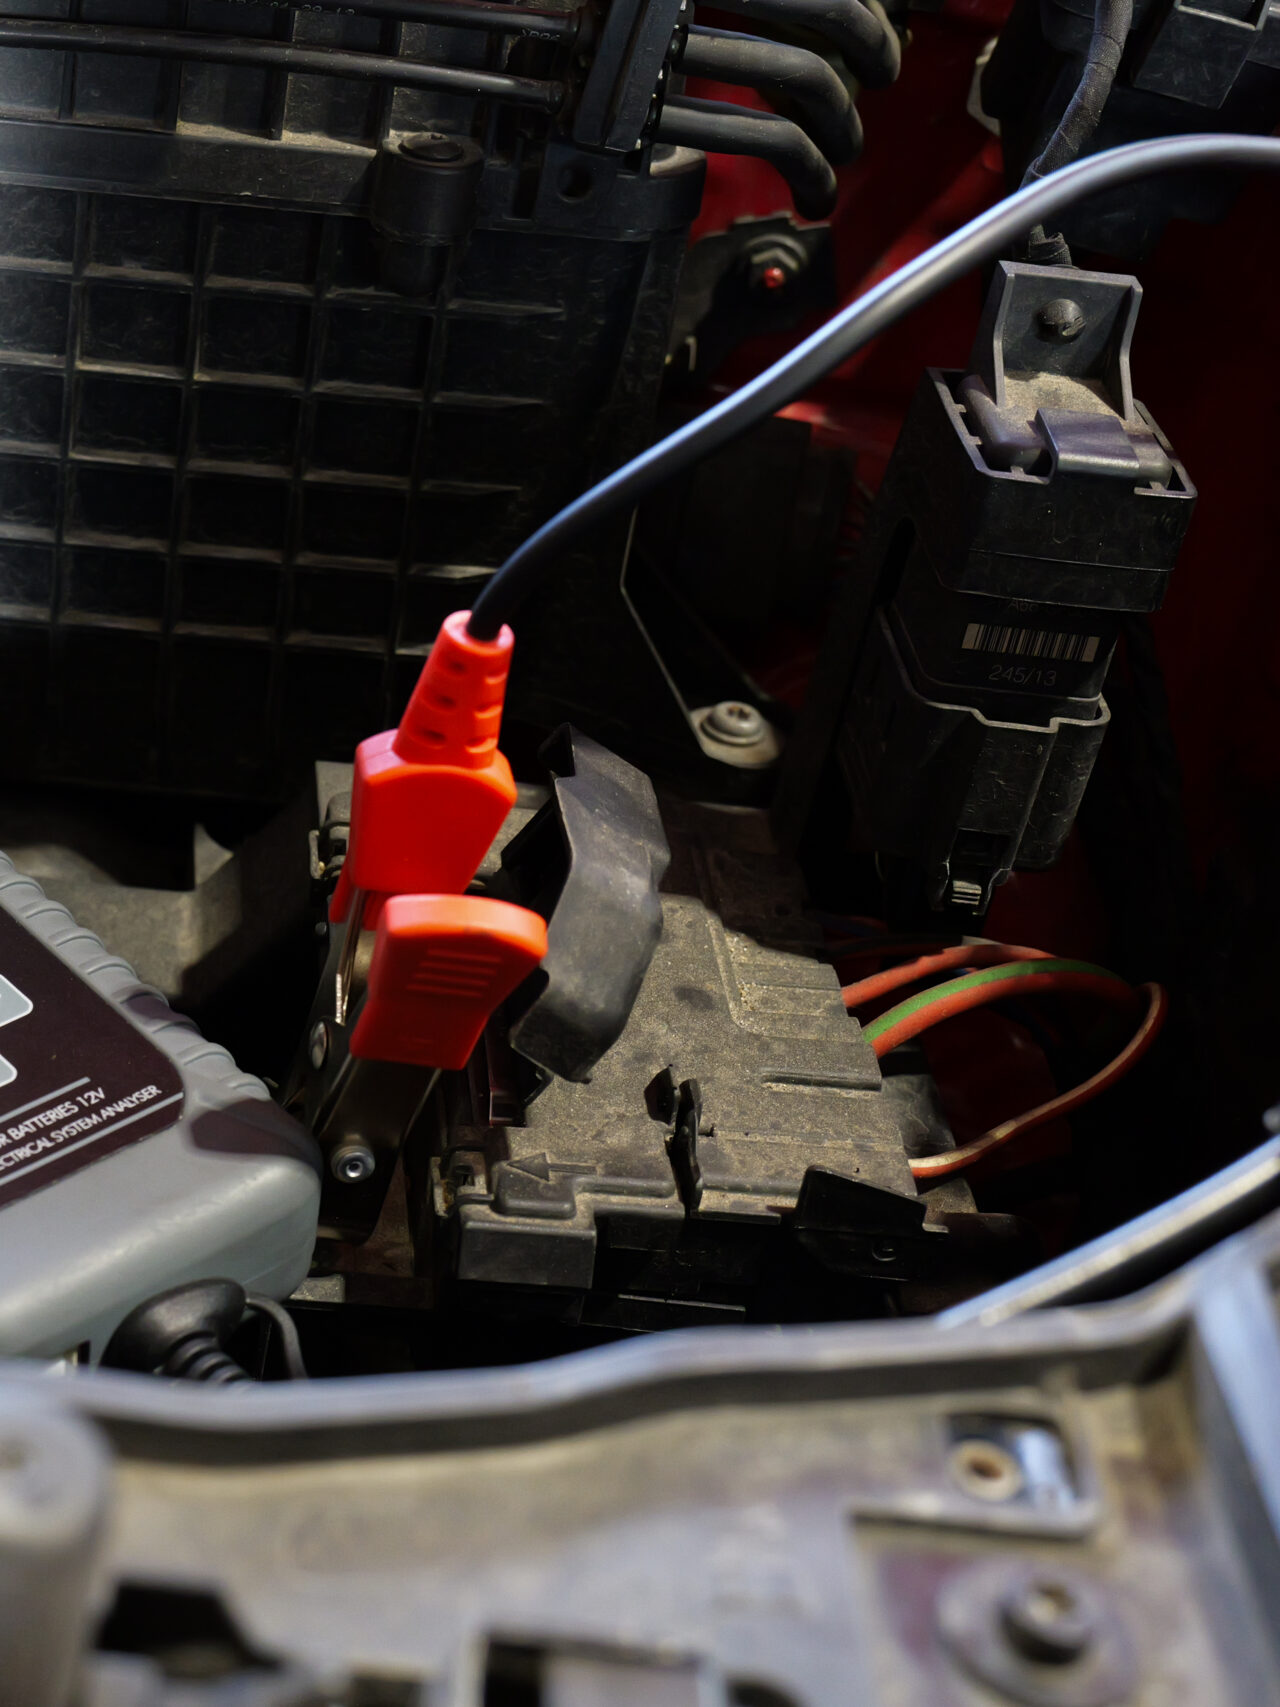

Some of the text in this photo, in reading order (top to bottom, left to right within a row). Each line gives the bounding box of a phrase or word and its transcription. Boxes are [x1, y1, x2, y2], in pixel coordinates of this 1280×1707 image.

[989, 665, 1057, 686] 245/13
[7, 1100, 80, 1142] BATTERIES
[77, 1087, 107, 1111] 12V
[54, 1112, 103, 1145] SYSTEM
[100, 1084, 163, 1121] ANALYSER
